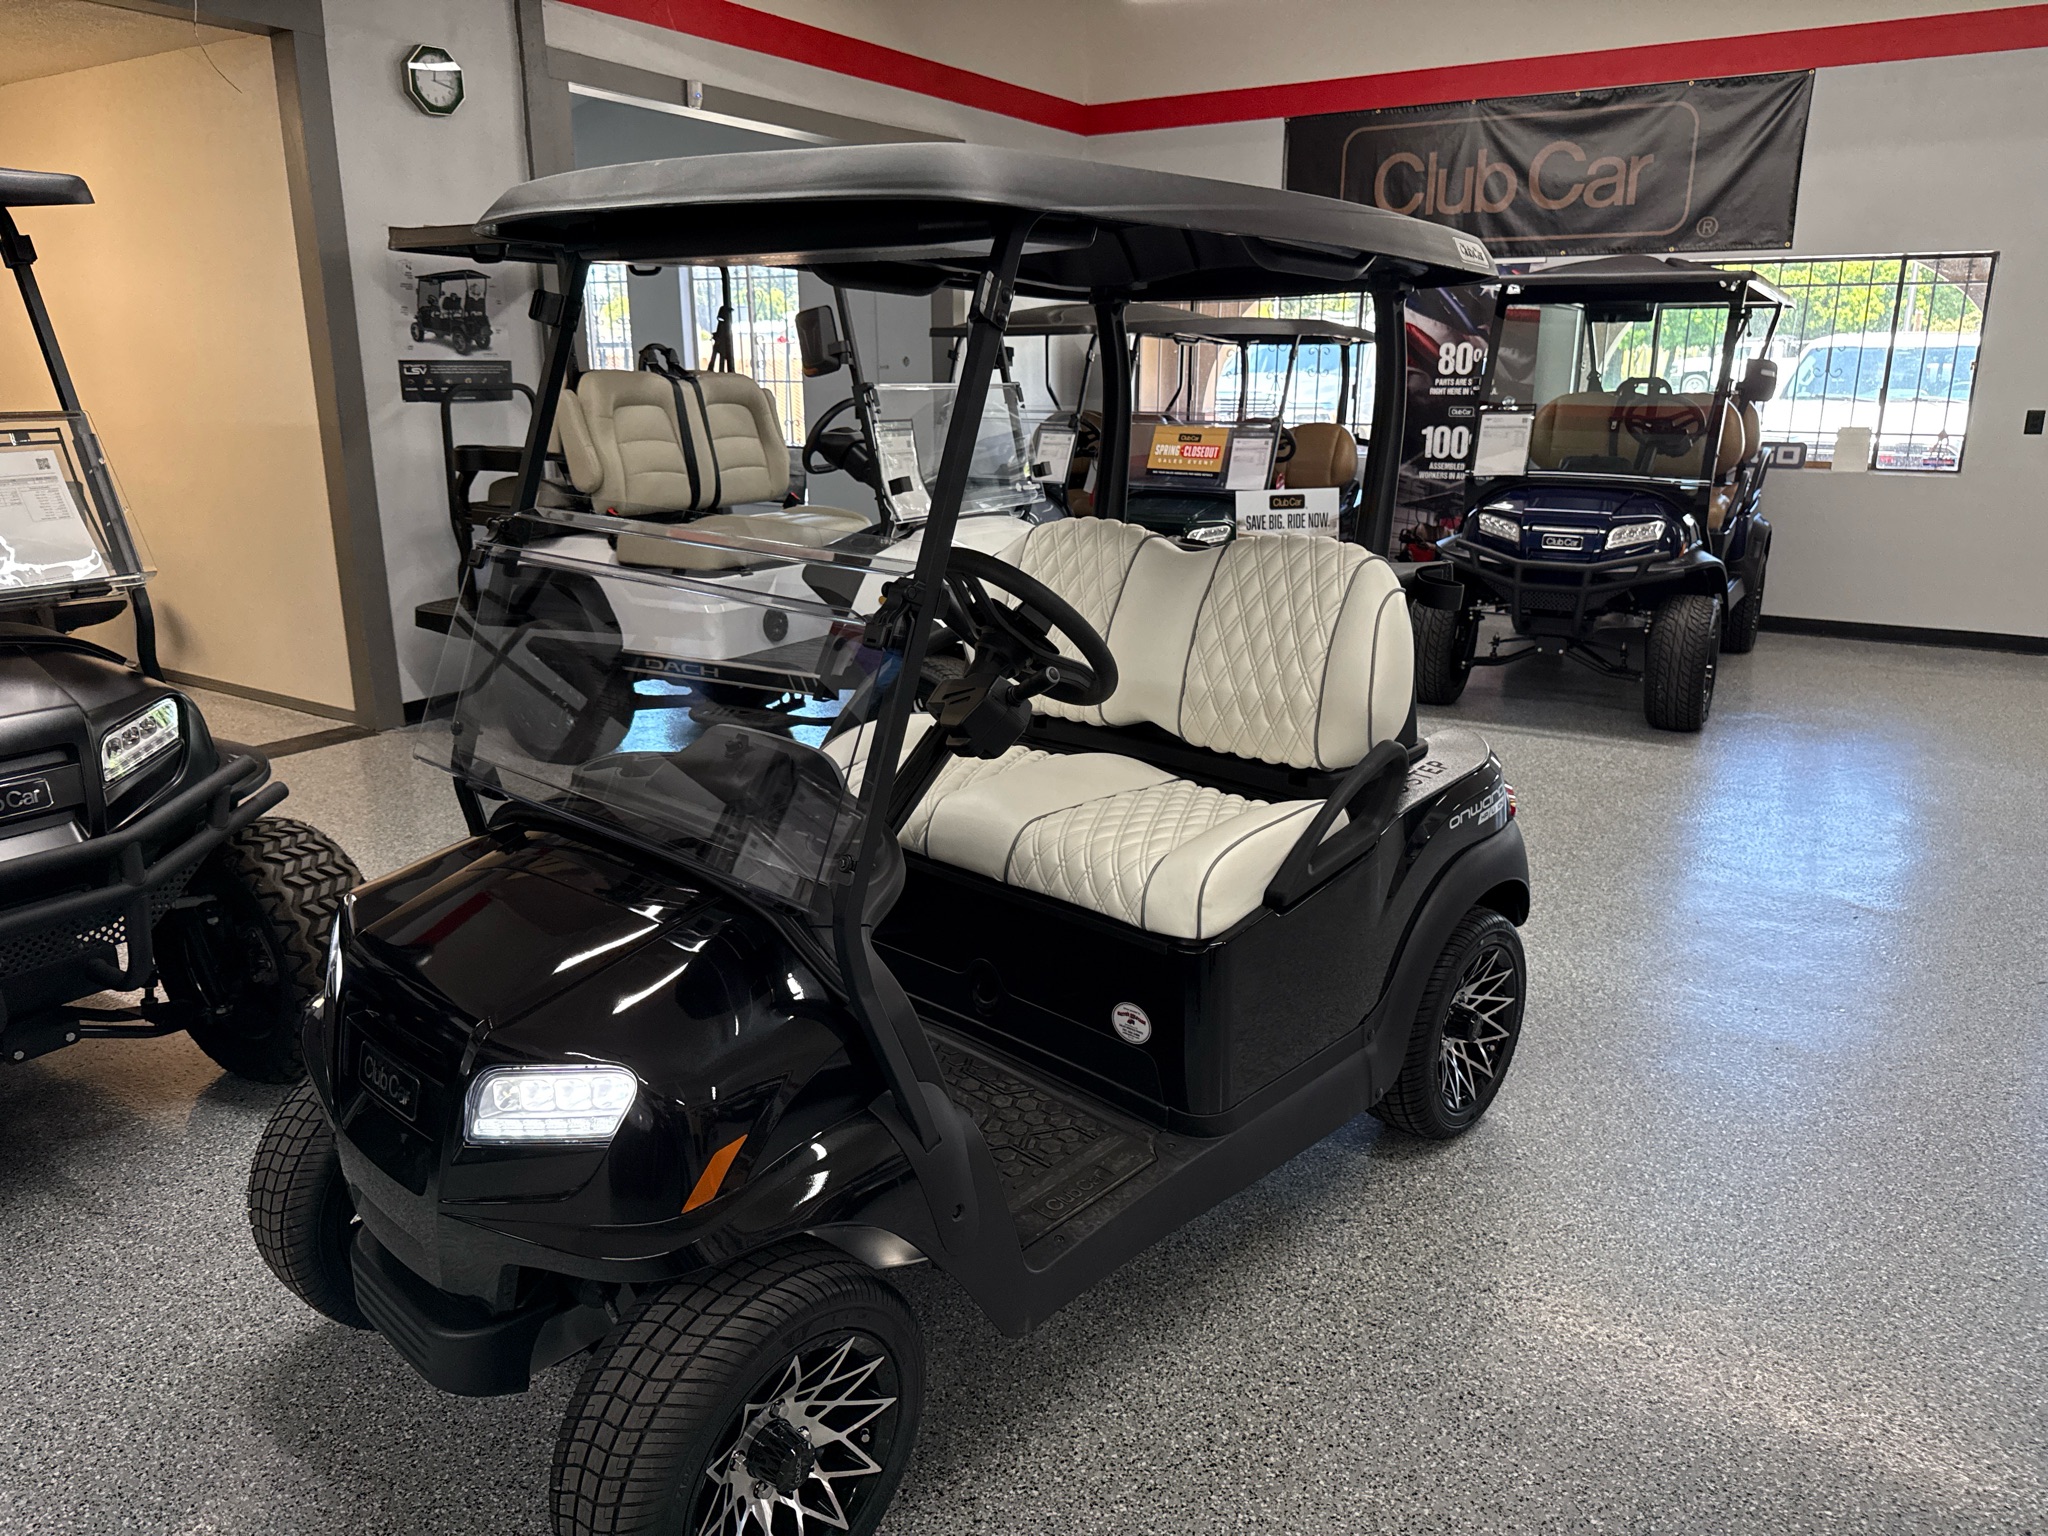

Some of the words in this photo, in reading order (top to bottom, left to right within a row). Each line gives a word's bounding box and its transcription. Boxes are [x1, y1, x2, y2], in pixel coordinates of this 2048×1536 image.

[1374, 149, 1518, 216] Club
[1528, 140, 1655, 211] Car
[1434, 378, 1454, 386] PARTS
[1155, 444, 1180, 456] SPRING
[1183, 445, 1220, 458] CLOSEOUT
[1421, 425, 1472, 459] 100
[1419, 471, 1448, 479] WORKERS
[1429, 462, 1465, 470] ASSEMBLED
[1246, 514, 1266, 530] SAVE
[1269, 514, 1285, 530] BIG.
[1287, 513, 1306, 529] RIDE
[1308, 512, 1330, 528] NOW.
[645, 658, 720, 678] DACH
[6, 789, 40, 808] Car
